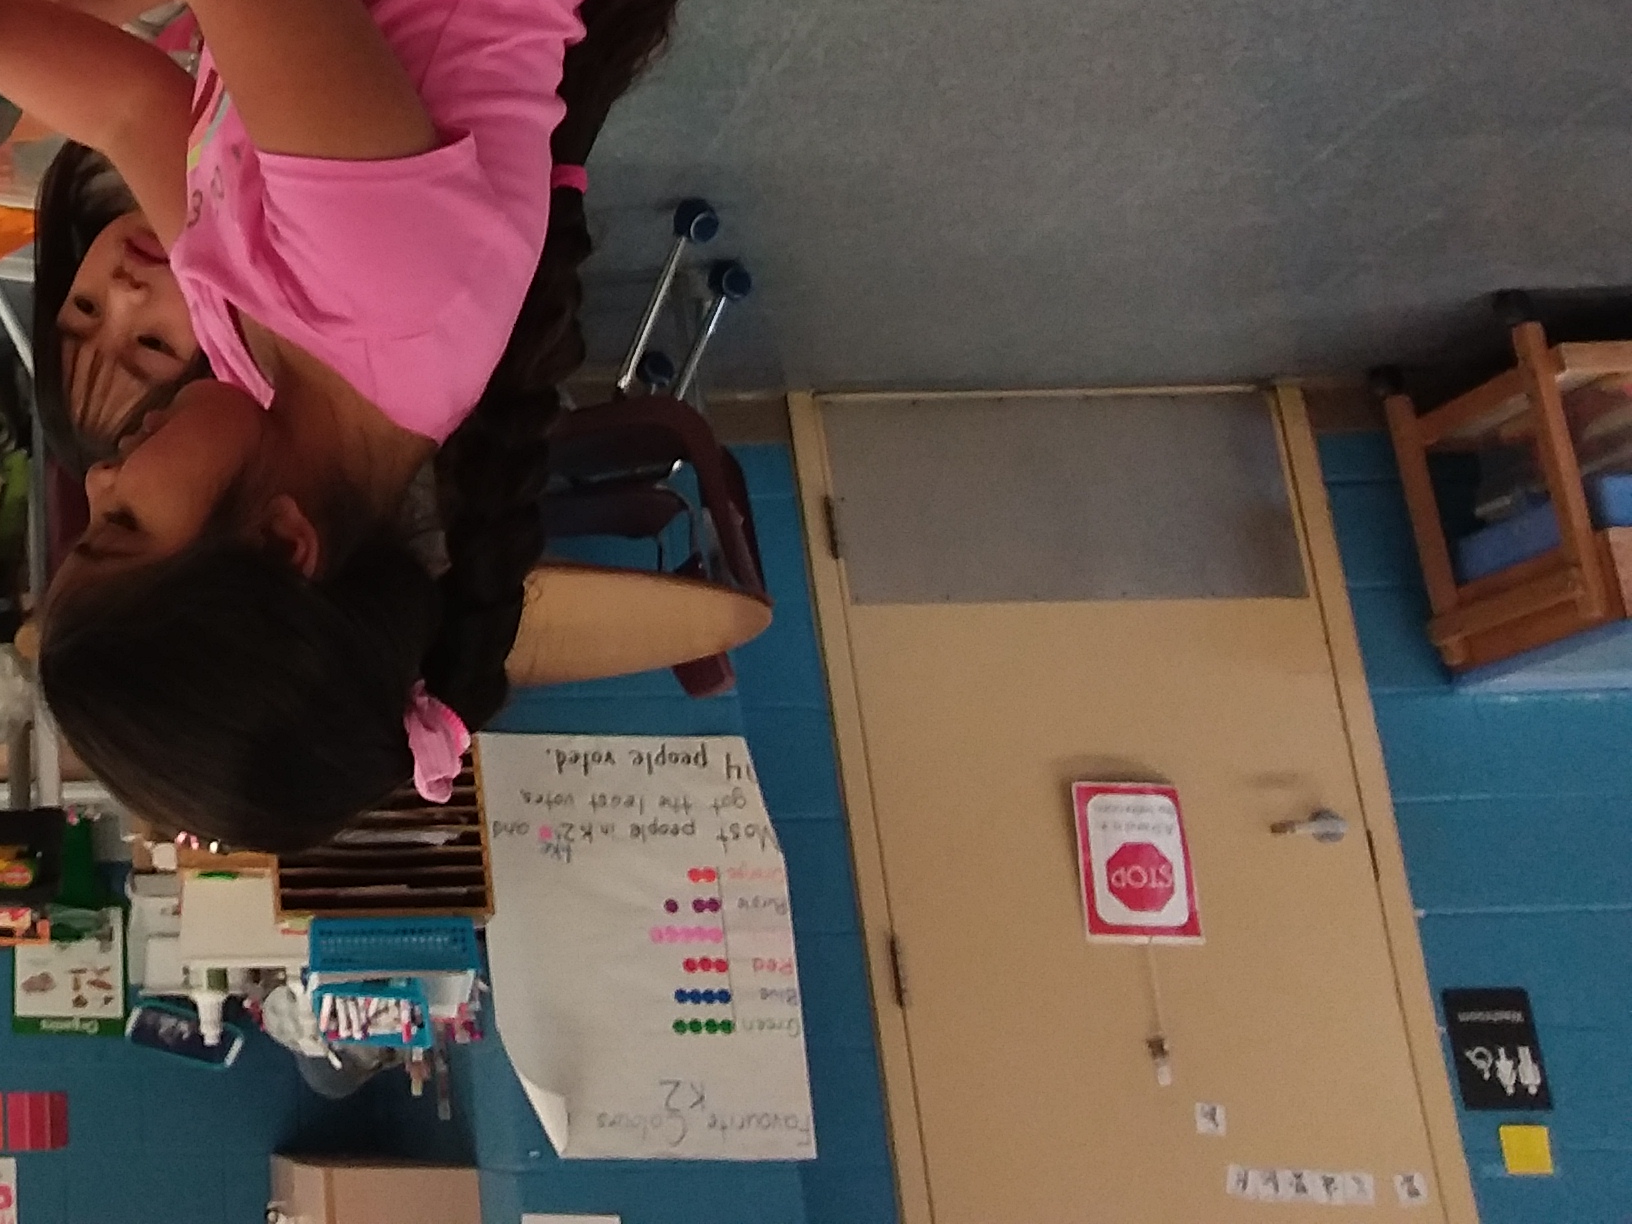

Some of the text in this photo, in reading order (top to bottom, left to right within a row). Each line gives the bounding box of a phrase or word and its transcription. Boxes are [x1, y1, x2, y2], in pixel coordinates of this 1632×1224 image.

[546, 749, 616, 777] voted.
[628, 744, 709, 776] people
[587, 793, 645, 815] least
[658, 794, 692, 816] the
[712, 787, 746, 817] got
[492, 820, 530, 838] and
[628, 817, 696, 845] people
[1111, 864, 1174, 889] STOP
[752, 957, 794, 976] Red
[760, 987, 798, 1007] Blue
[739, 1018, 800, 1038] Green
[595, 1112, 812, 1149] Favourite Colours
